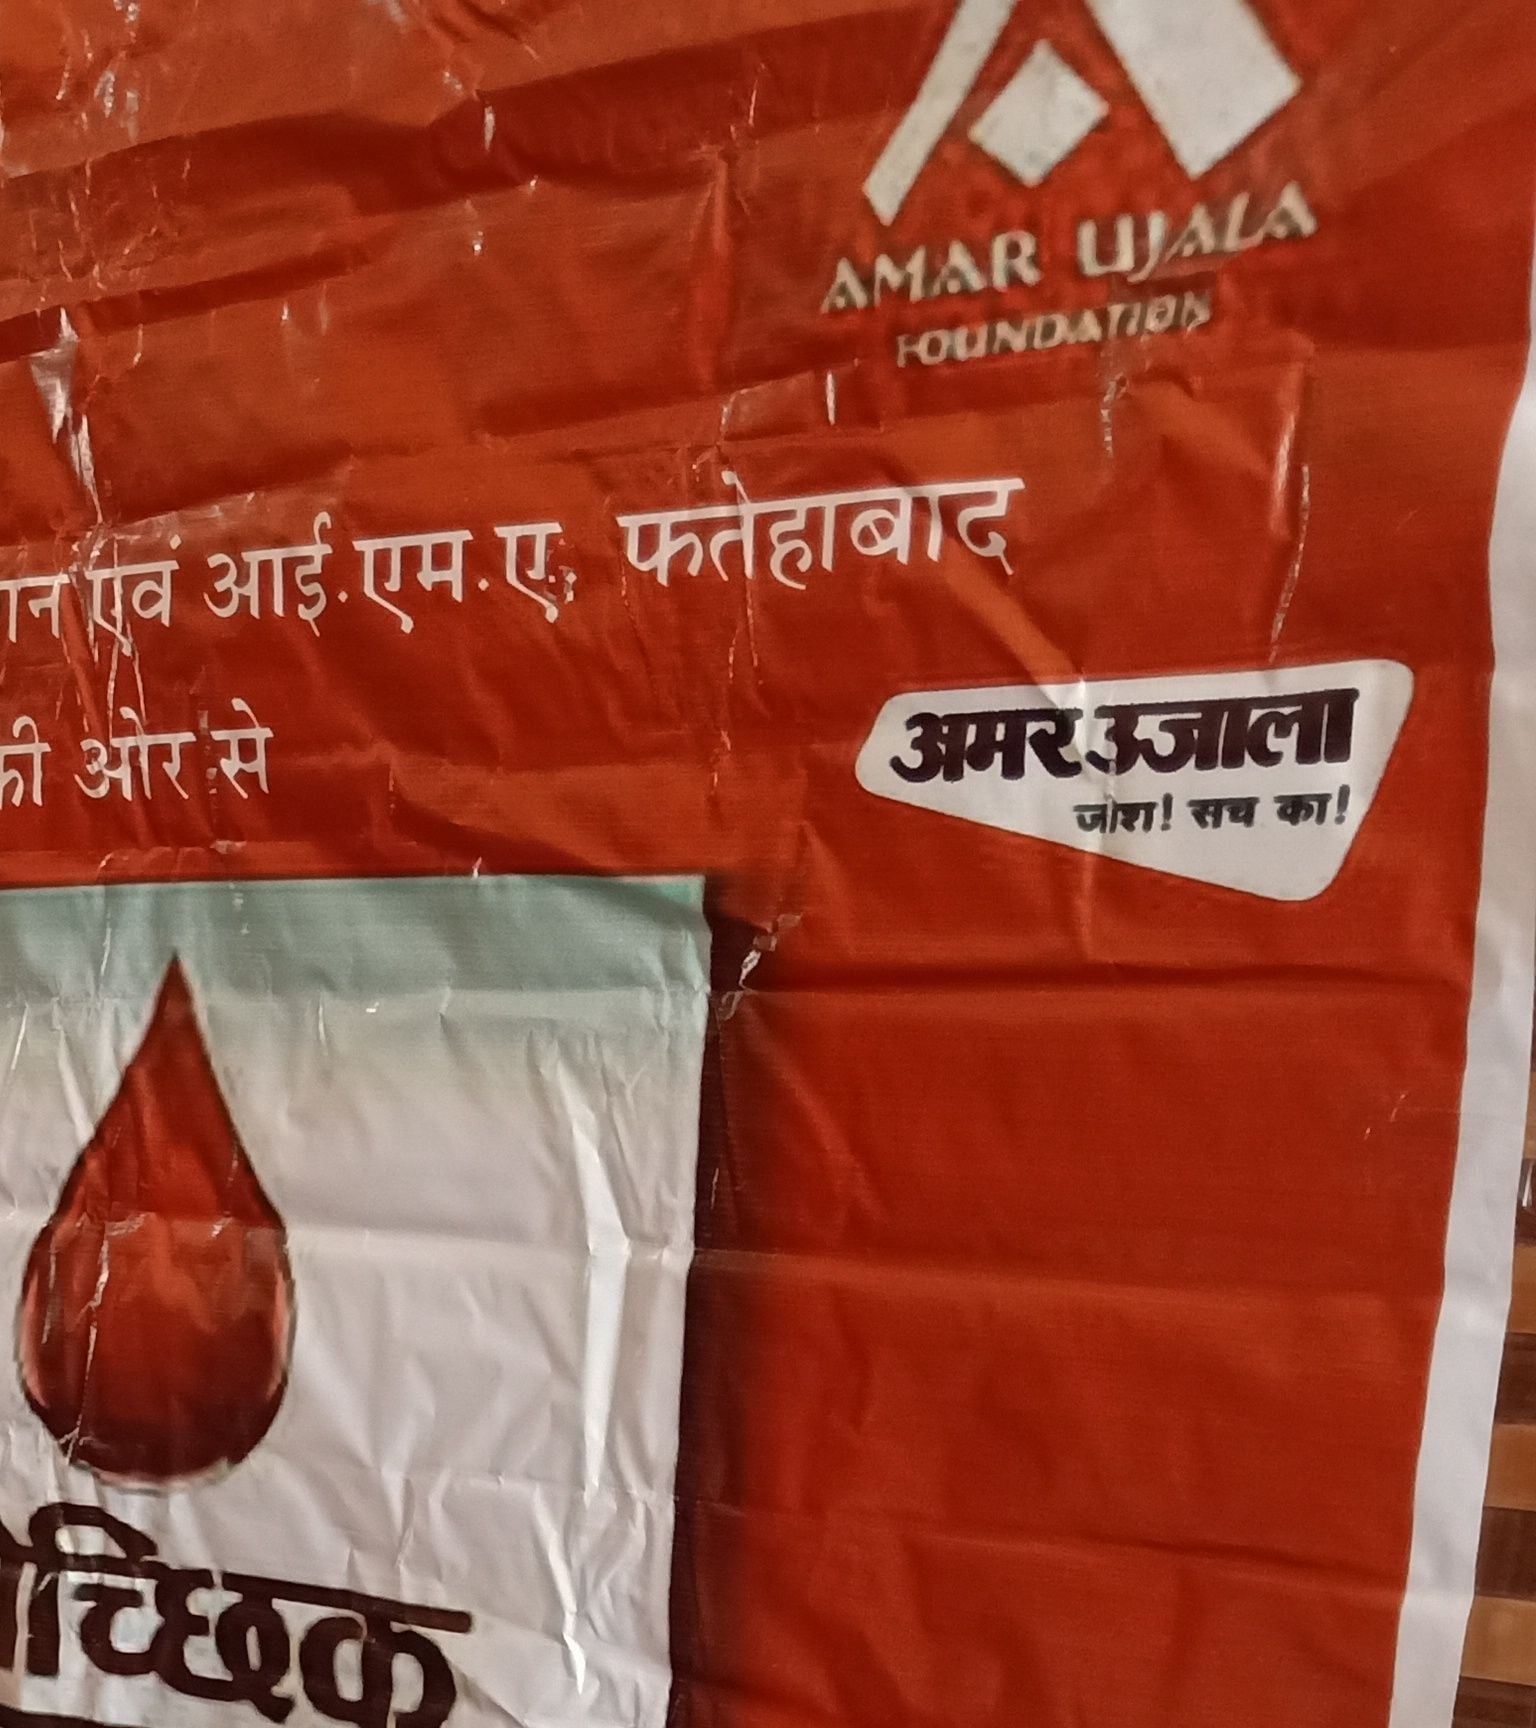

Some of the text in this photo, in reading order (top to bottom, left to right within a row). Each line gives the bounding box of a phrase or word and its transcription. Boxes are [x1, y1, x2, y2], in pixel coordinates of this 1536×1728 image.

[819, 181, 1320, 314] AMAR UJALA
[897, 289, 1213, 368] FOUNDATION
[84, 535, 181, 656] एवं
[616, 470, 1025, 590] फतेहाबाद
[74, 706, 195, 802] ओर
[209, 698, 274, 795] से
[889, 687, 1360, 783] अमर उजाला
[1186, 796, 1260, 830] सच
